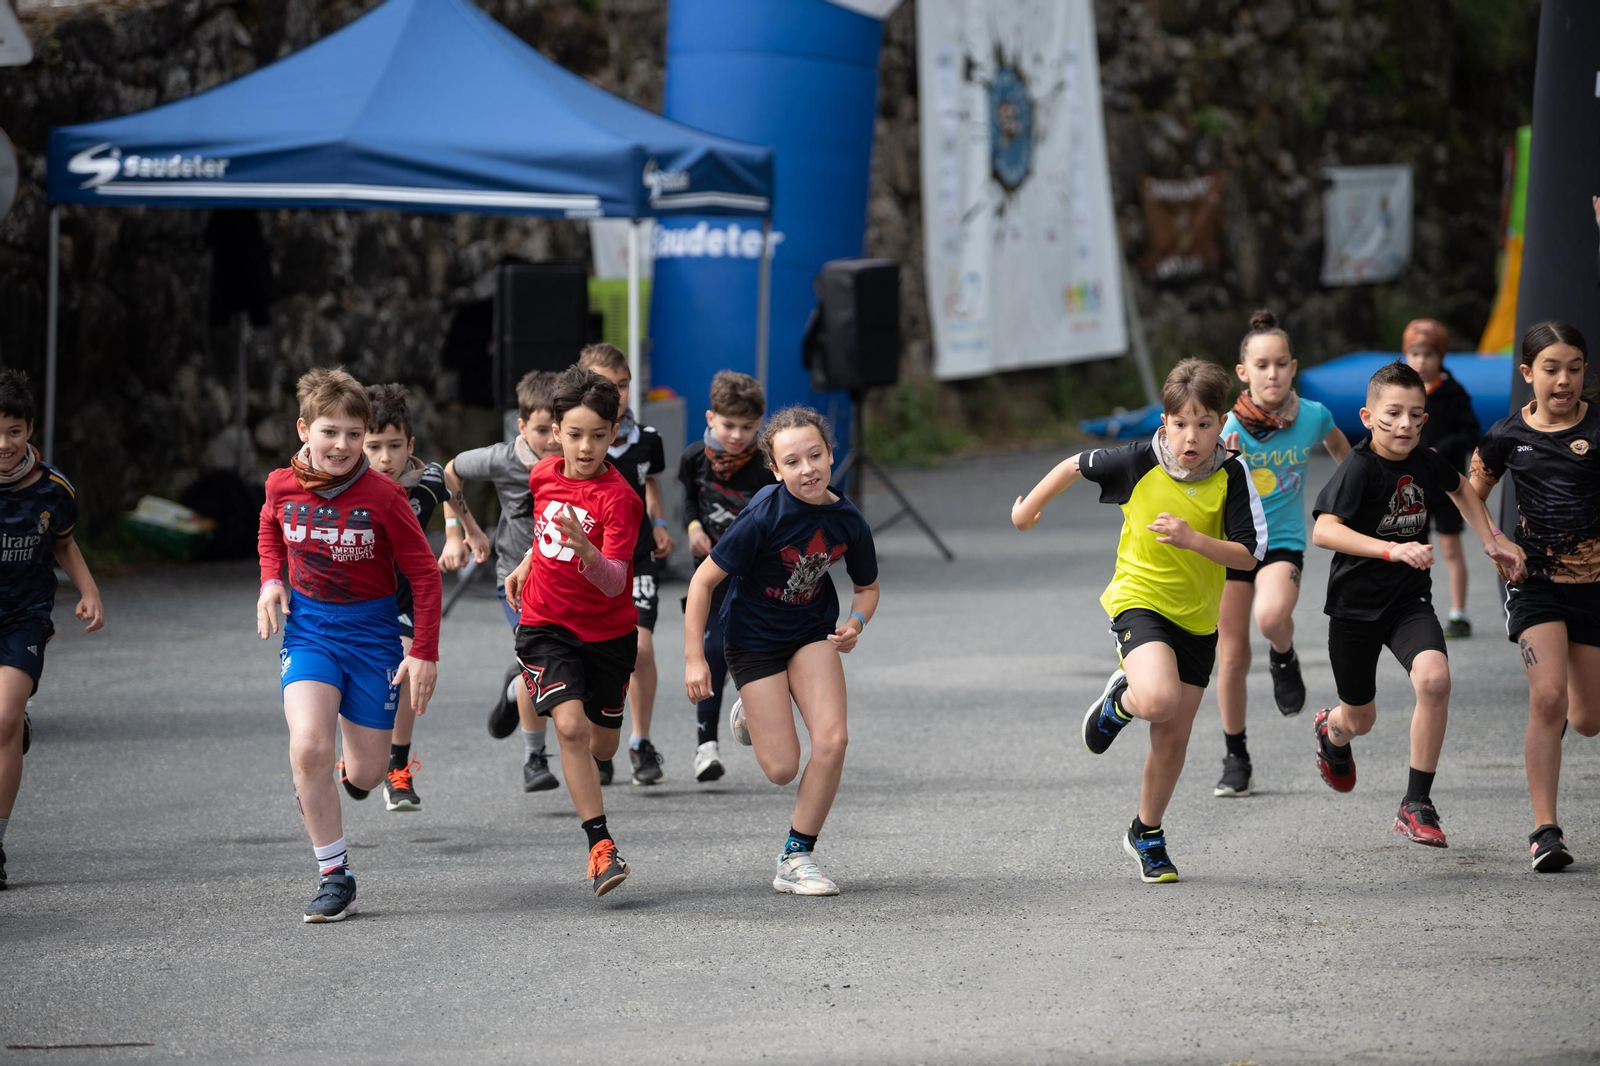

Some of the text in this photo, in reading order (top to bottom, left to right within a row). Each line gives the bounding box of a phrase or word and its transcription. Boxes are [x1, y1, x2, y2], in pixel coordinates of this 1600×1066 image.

[123, 154, 230, 178] Saudeter
[283, 501, 376, 546] USA
[534, 515, 547, 541] SIX
[1401, 526, 1416, 534] RACE
[1, 548, 34, 562] BETTER
[329, 543, 375, 556] AMERICAN
[331, 550, 375, 562] FOOTBALL
